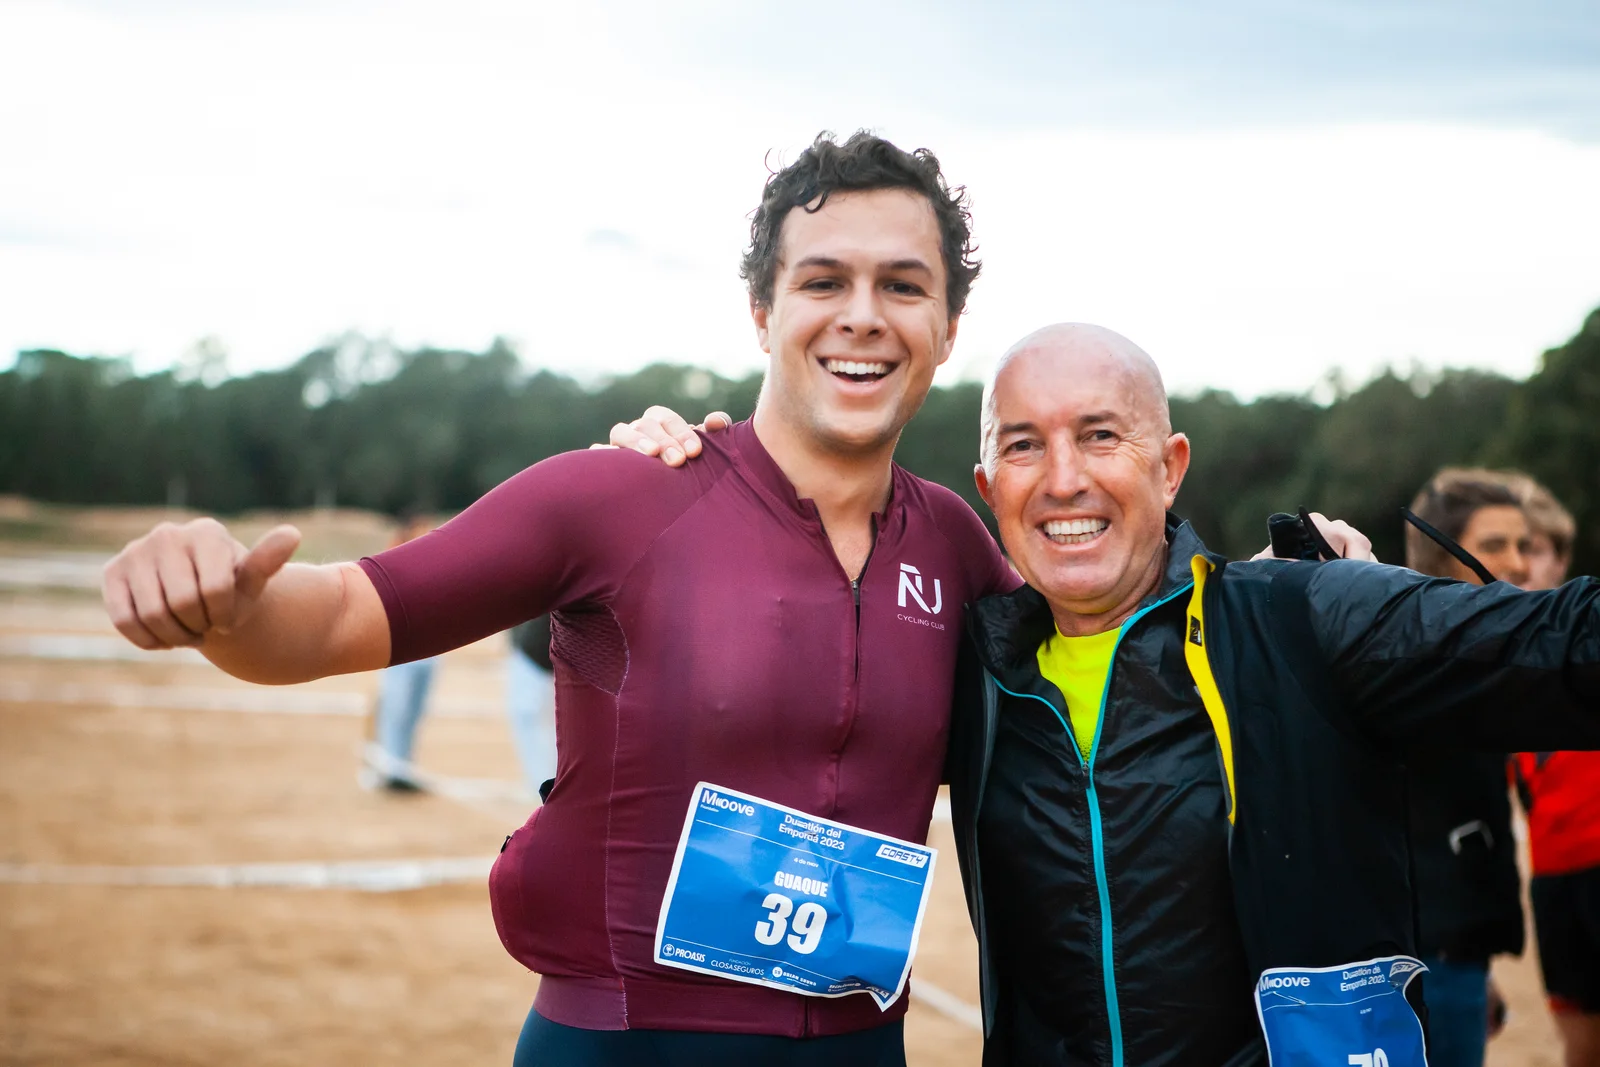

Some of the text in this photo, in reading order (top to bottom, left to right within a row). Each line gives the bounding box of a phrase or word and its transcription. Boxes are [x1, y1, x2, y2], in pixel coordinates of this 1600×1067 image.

[897, 613, 945, 631] CYCLING CLUB
[826, 827, 842, 839] del
[820, 836, 845, 850] 2023
[881, 847, 923, 864] COASTY
[774, 871, 829, 898] GUAQUE
[754, 893, 828, 955] 39
[674, 947, 706, 963] PROASIS
[710, 959, 765, 976] CLOSASEGUROS
[1368, 974, 1385, 985] 2023
